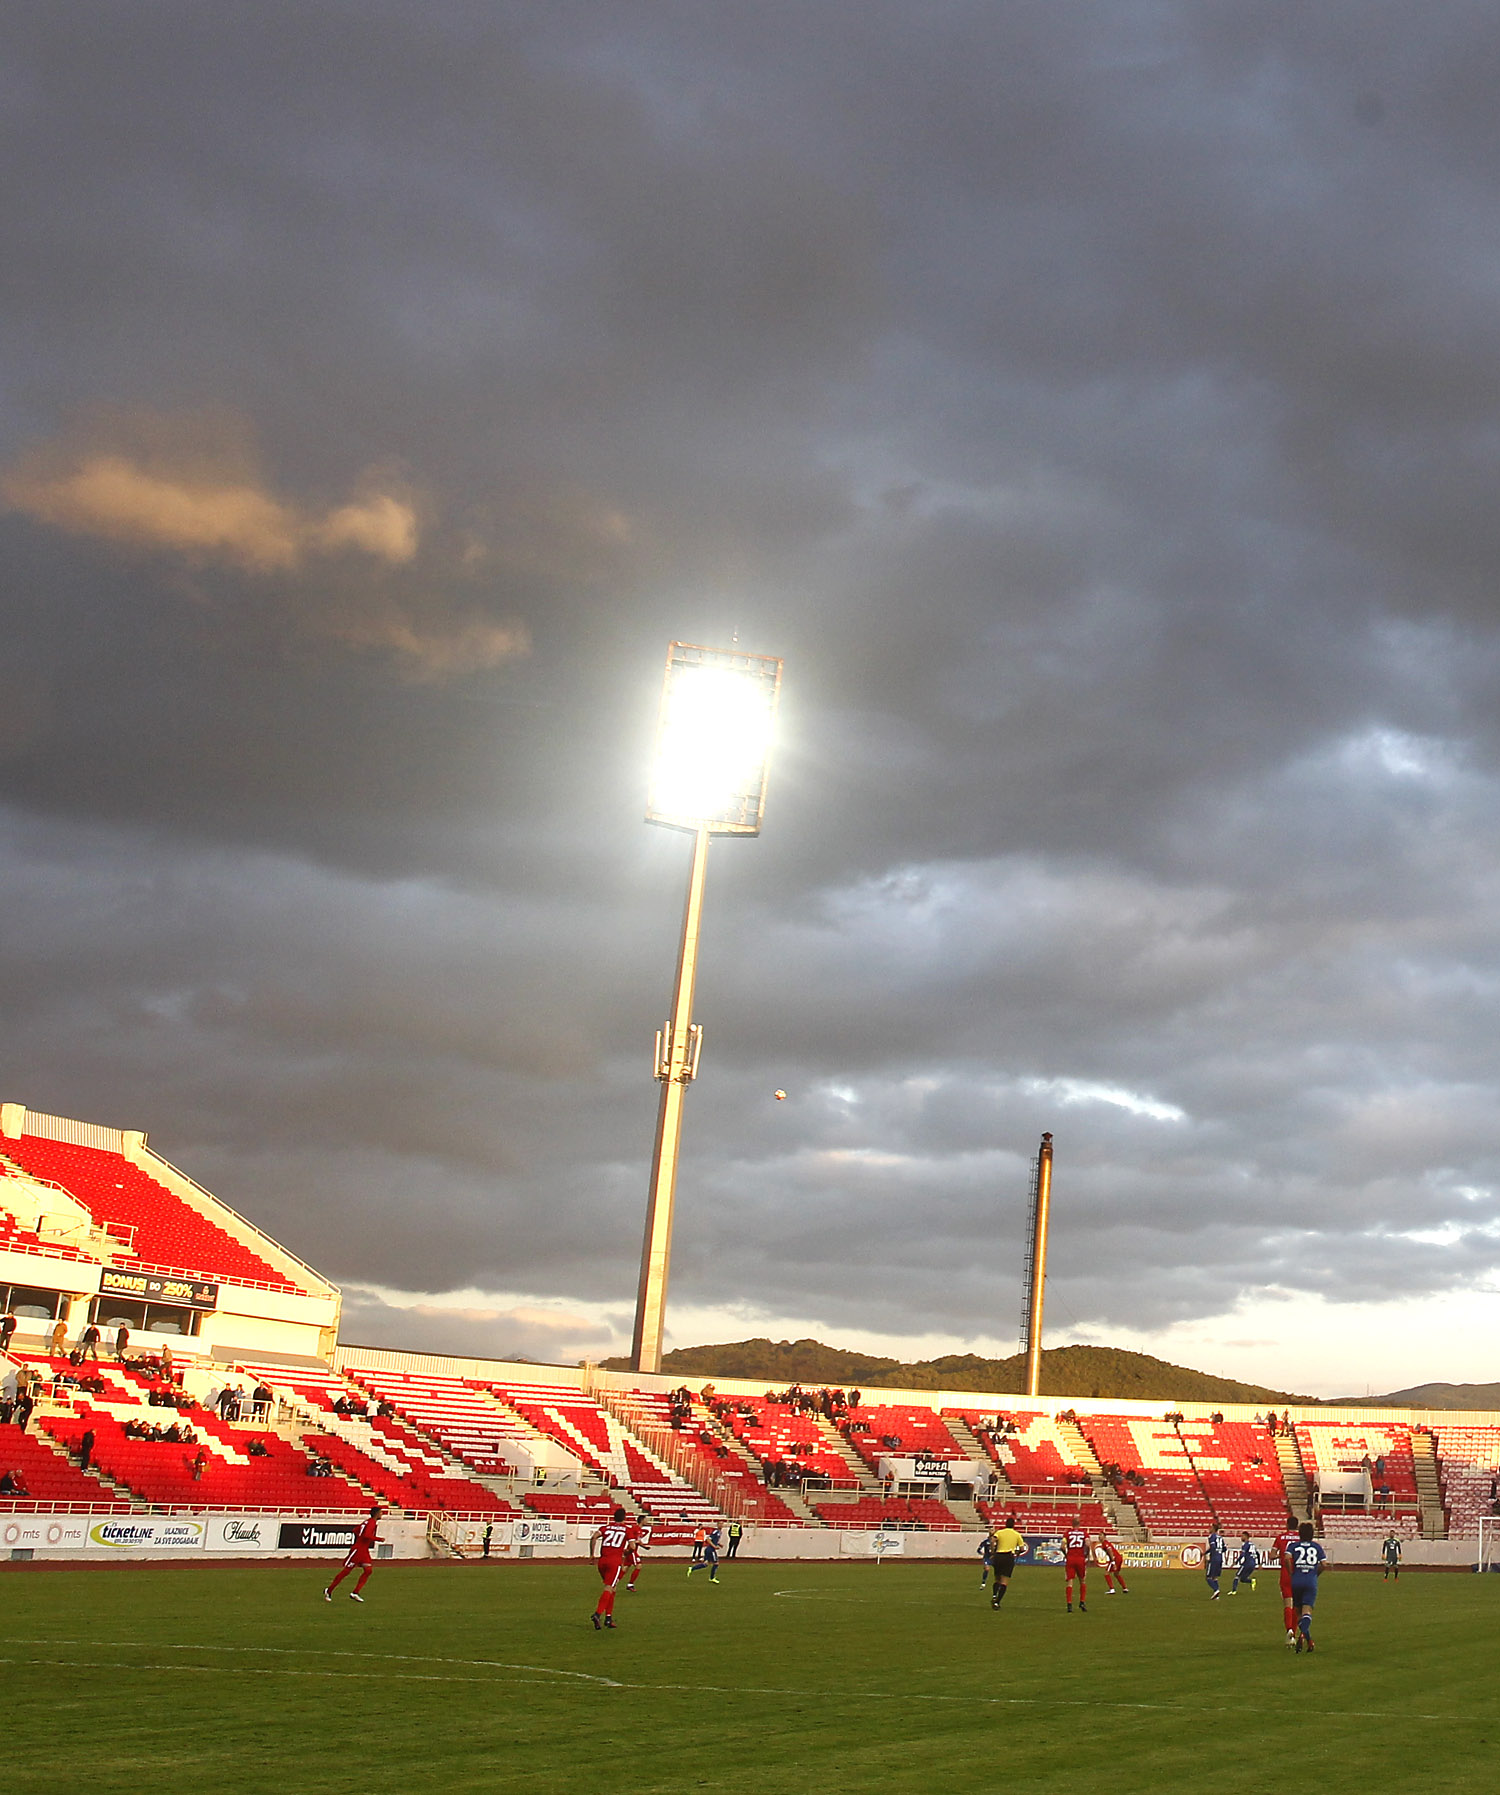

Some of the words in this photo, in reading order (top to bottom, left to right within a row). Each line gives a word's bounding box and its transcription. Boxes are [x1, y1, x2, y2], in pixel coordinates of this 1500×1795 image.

[149, 1281, 161, 1291] DO
[162, 1280, 193, 1298] 250%
[164, 1527, 189, 1535] ULAZNICE
[532, 1523, 552, 1532] MOTEL
[22, 1530, 40, 1539] mts
[64, 1530, 82, 1539] mts
[531, 1533, 565, 1543] PREDEJANE
[603, 1530, 625, 1548] 20
[1069, 1535, 1085, 1548] 25
[1294, 1546, 1318, 1565] 28
